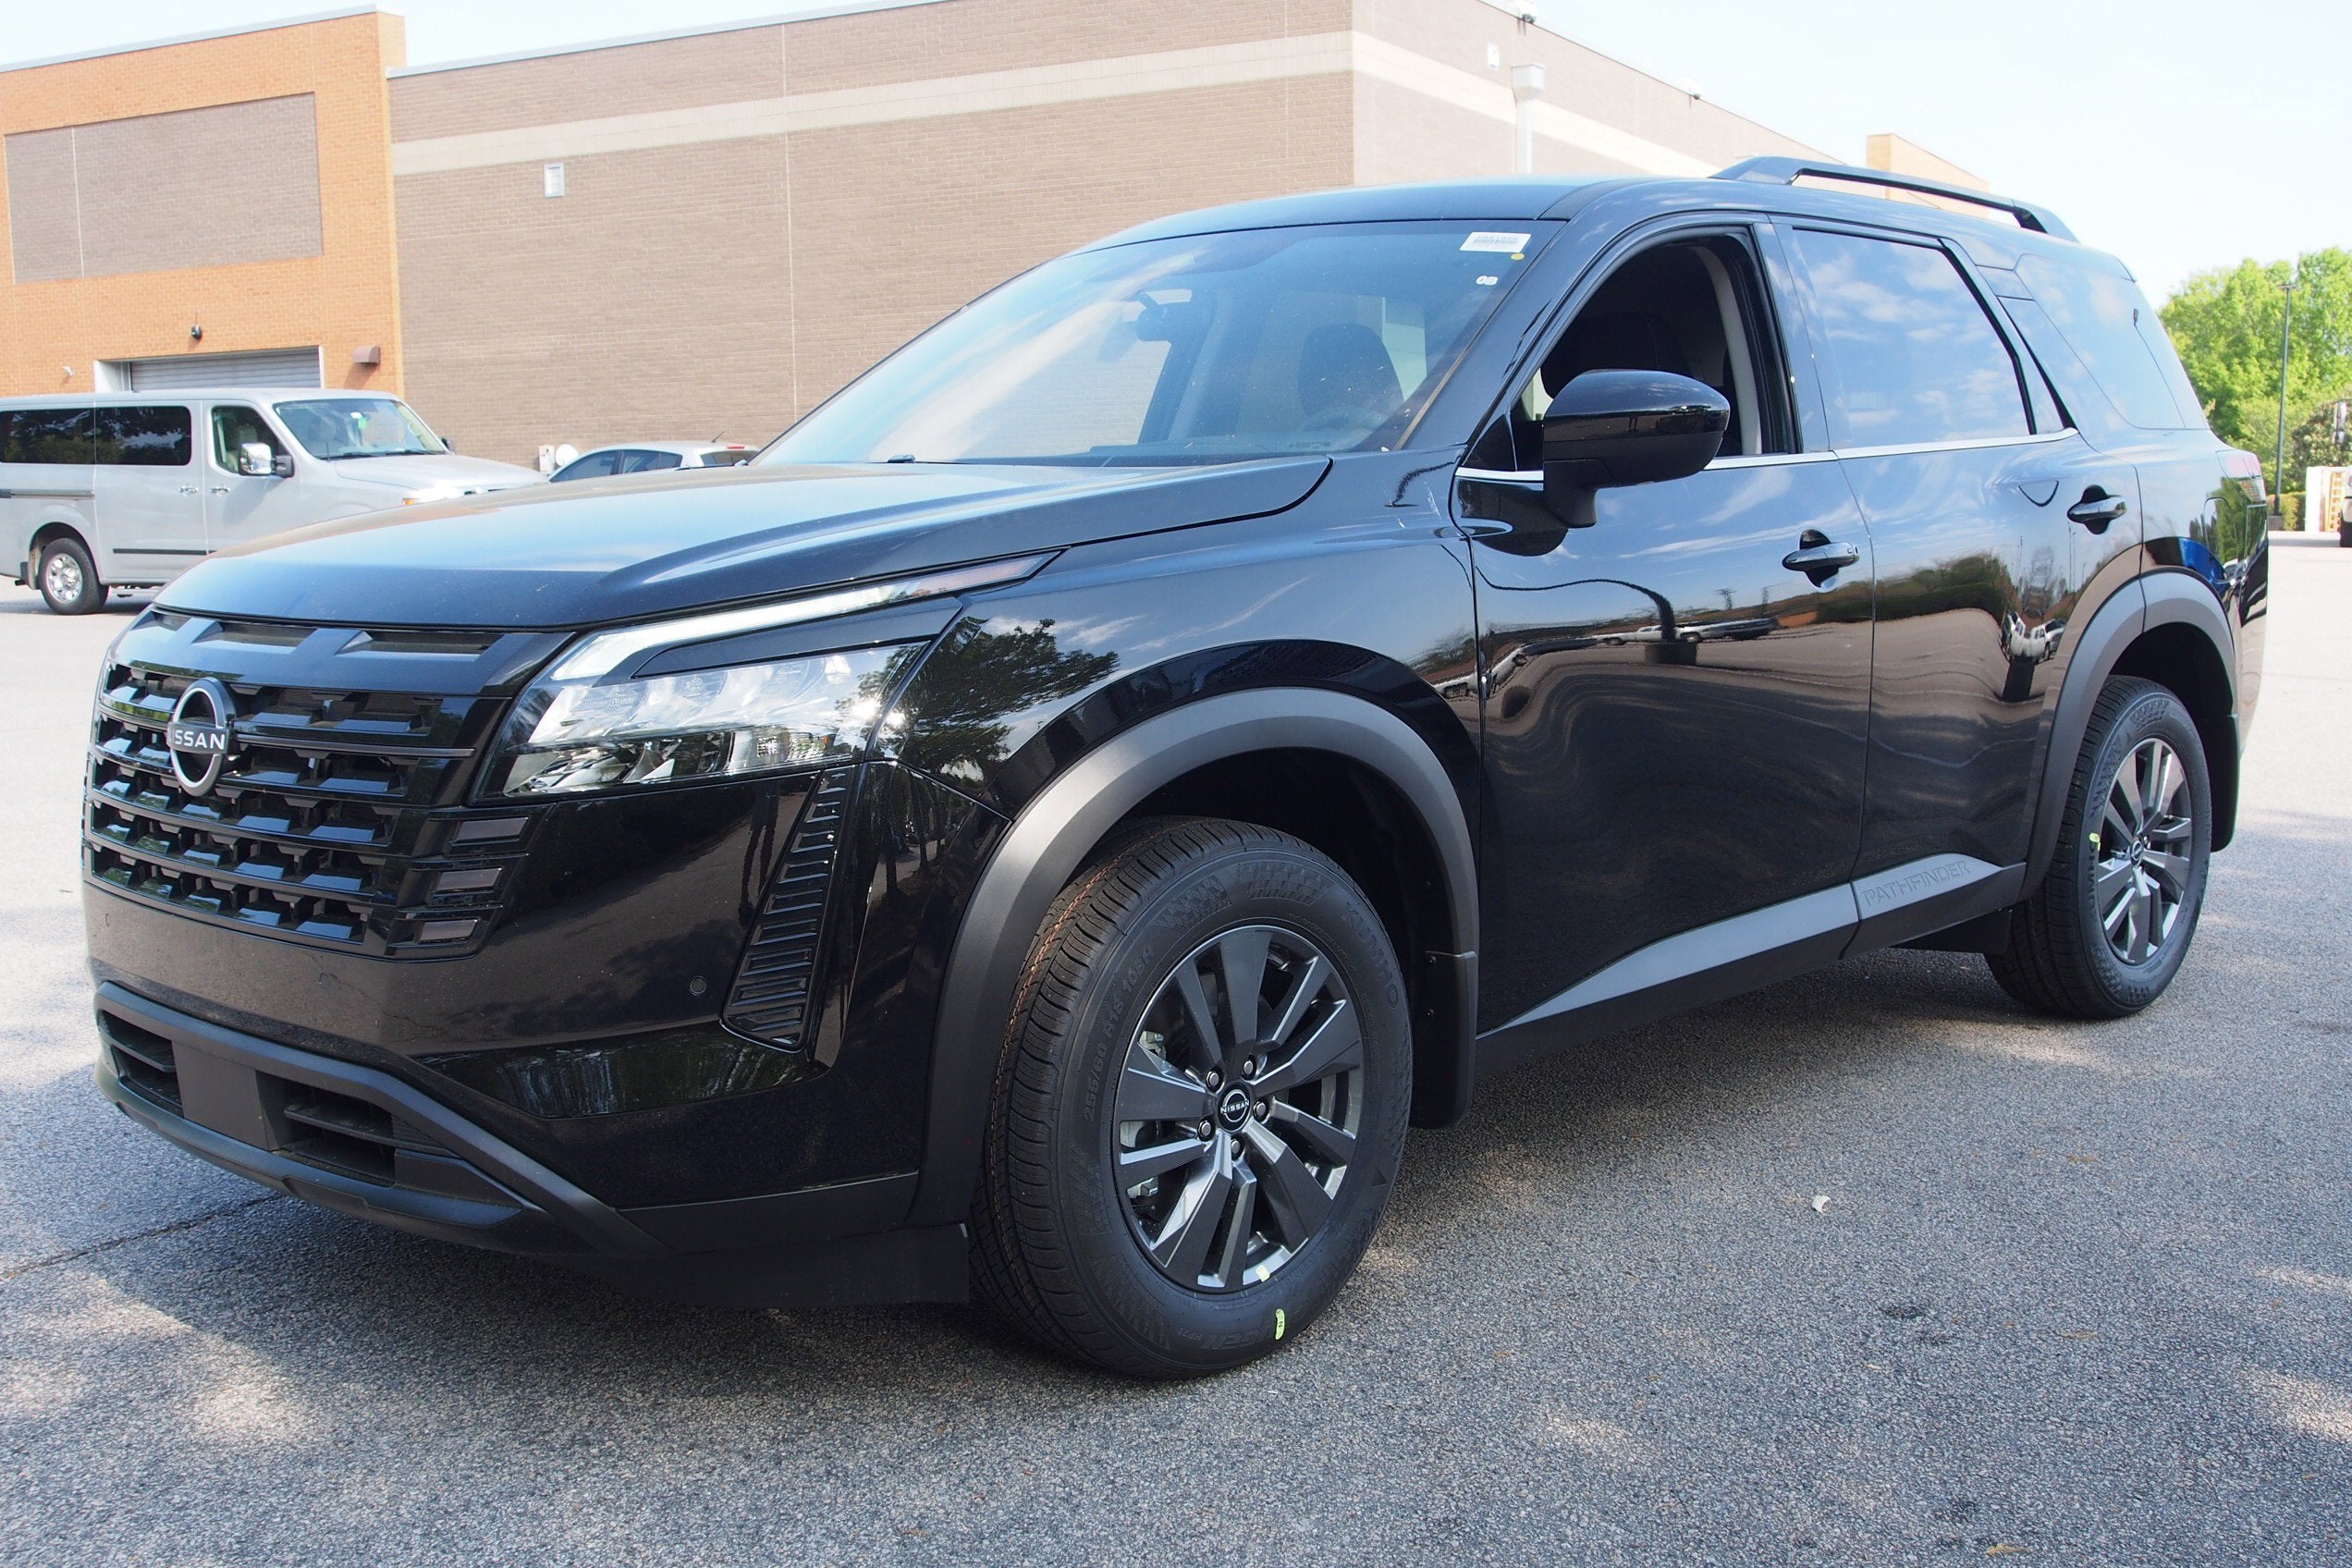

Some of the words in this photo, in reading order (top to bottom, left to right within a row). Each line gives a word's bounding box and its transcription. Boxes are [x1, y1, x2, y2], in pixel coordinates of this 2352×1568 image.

[167, 727, 225, 751] ISSAN
[1860, 860, 1972, 906] PATHFINDER
[1219, 1099, 1250, 1115] NISSAN
